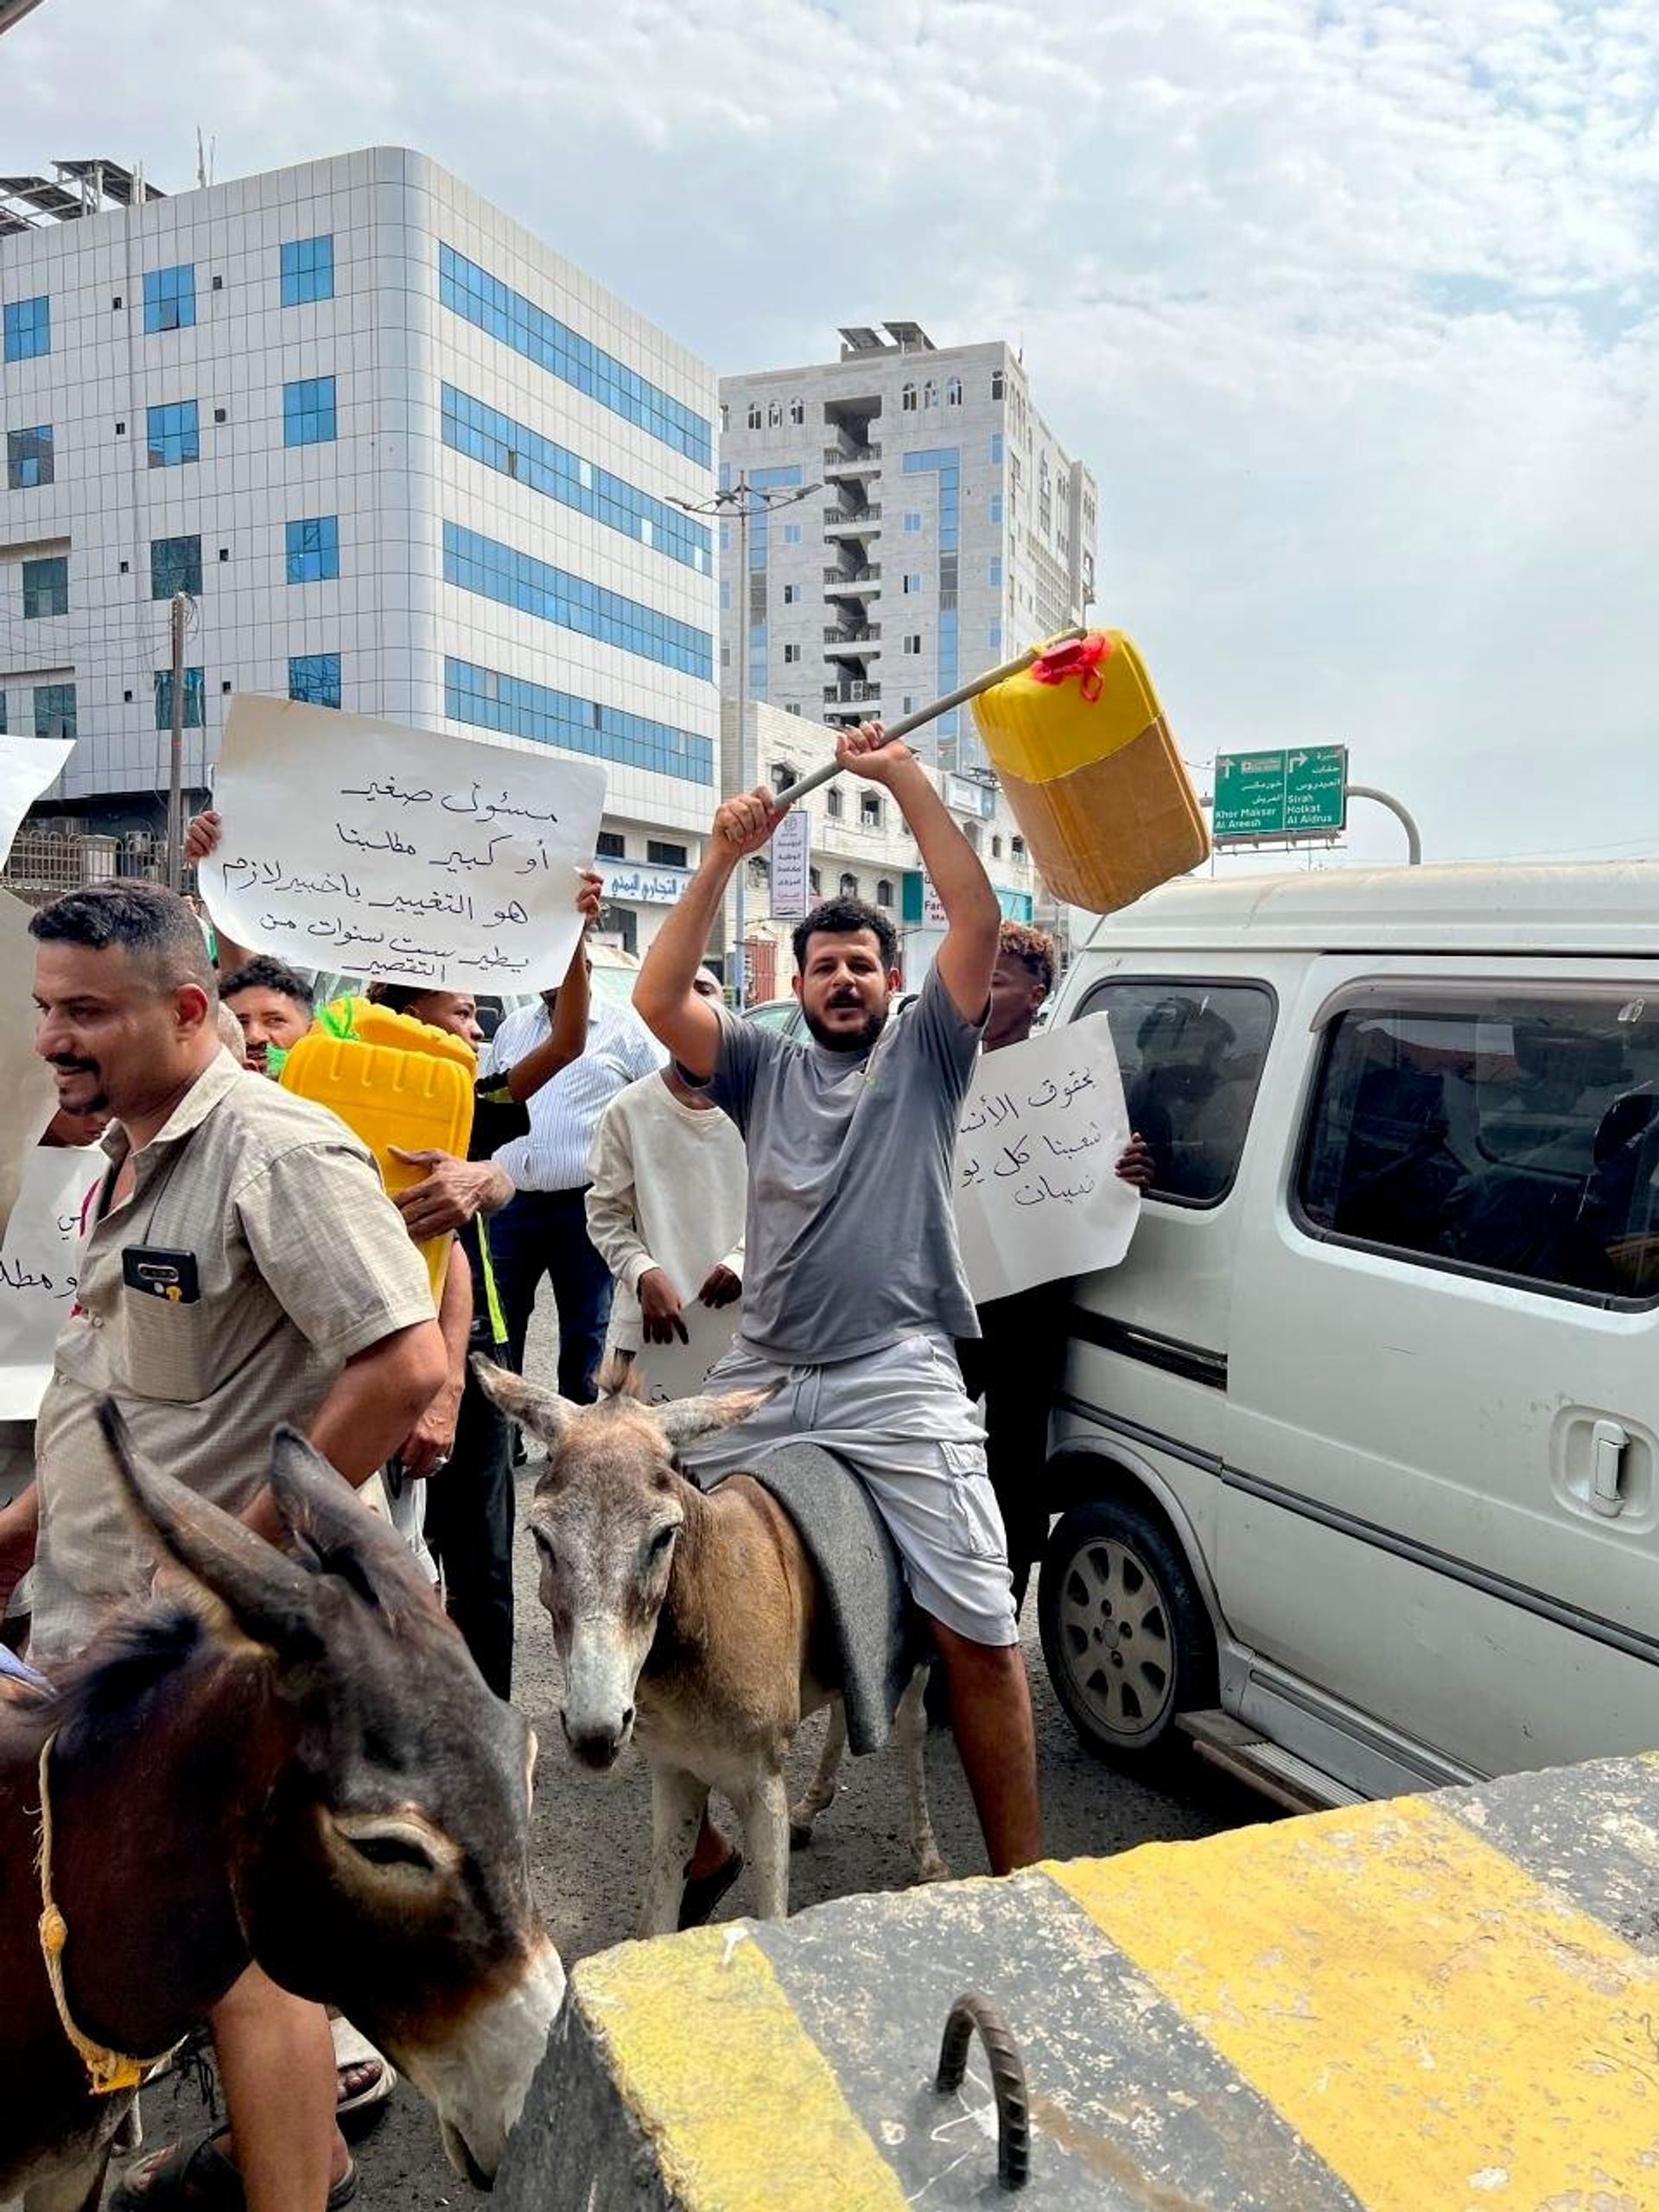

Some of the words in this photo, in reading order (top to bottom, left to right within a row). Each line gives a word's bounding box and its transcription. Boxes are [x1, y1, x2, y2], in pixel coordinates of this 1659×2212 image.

[341, 776, 433, 806] صغير
[1241, 808, 1276, 817] Maksar
[429, 834, 513, 874] كبير
[514, 839, 549, 874] أو
[223, 858, 282, 896] لازم
[368, 892, 473, 920] التغيير
[481, 899, 529, 927] هو
[260, 913, 297, 931] من
[308, 917, 385, 946] سنوات
[341, 957, 446, 983] التقصير
[458, 945, 529, 973] يطير
[994, 1135, 1030, 1177] كل
